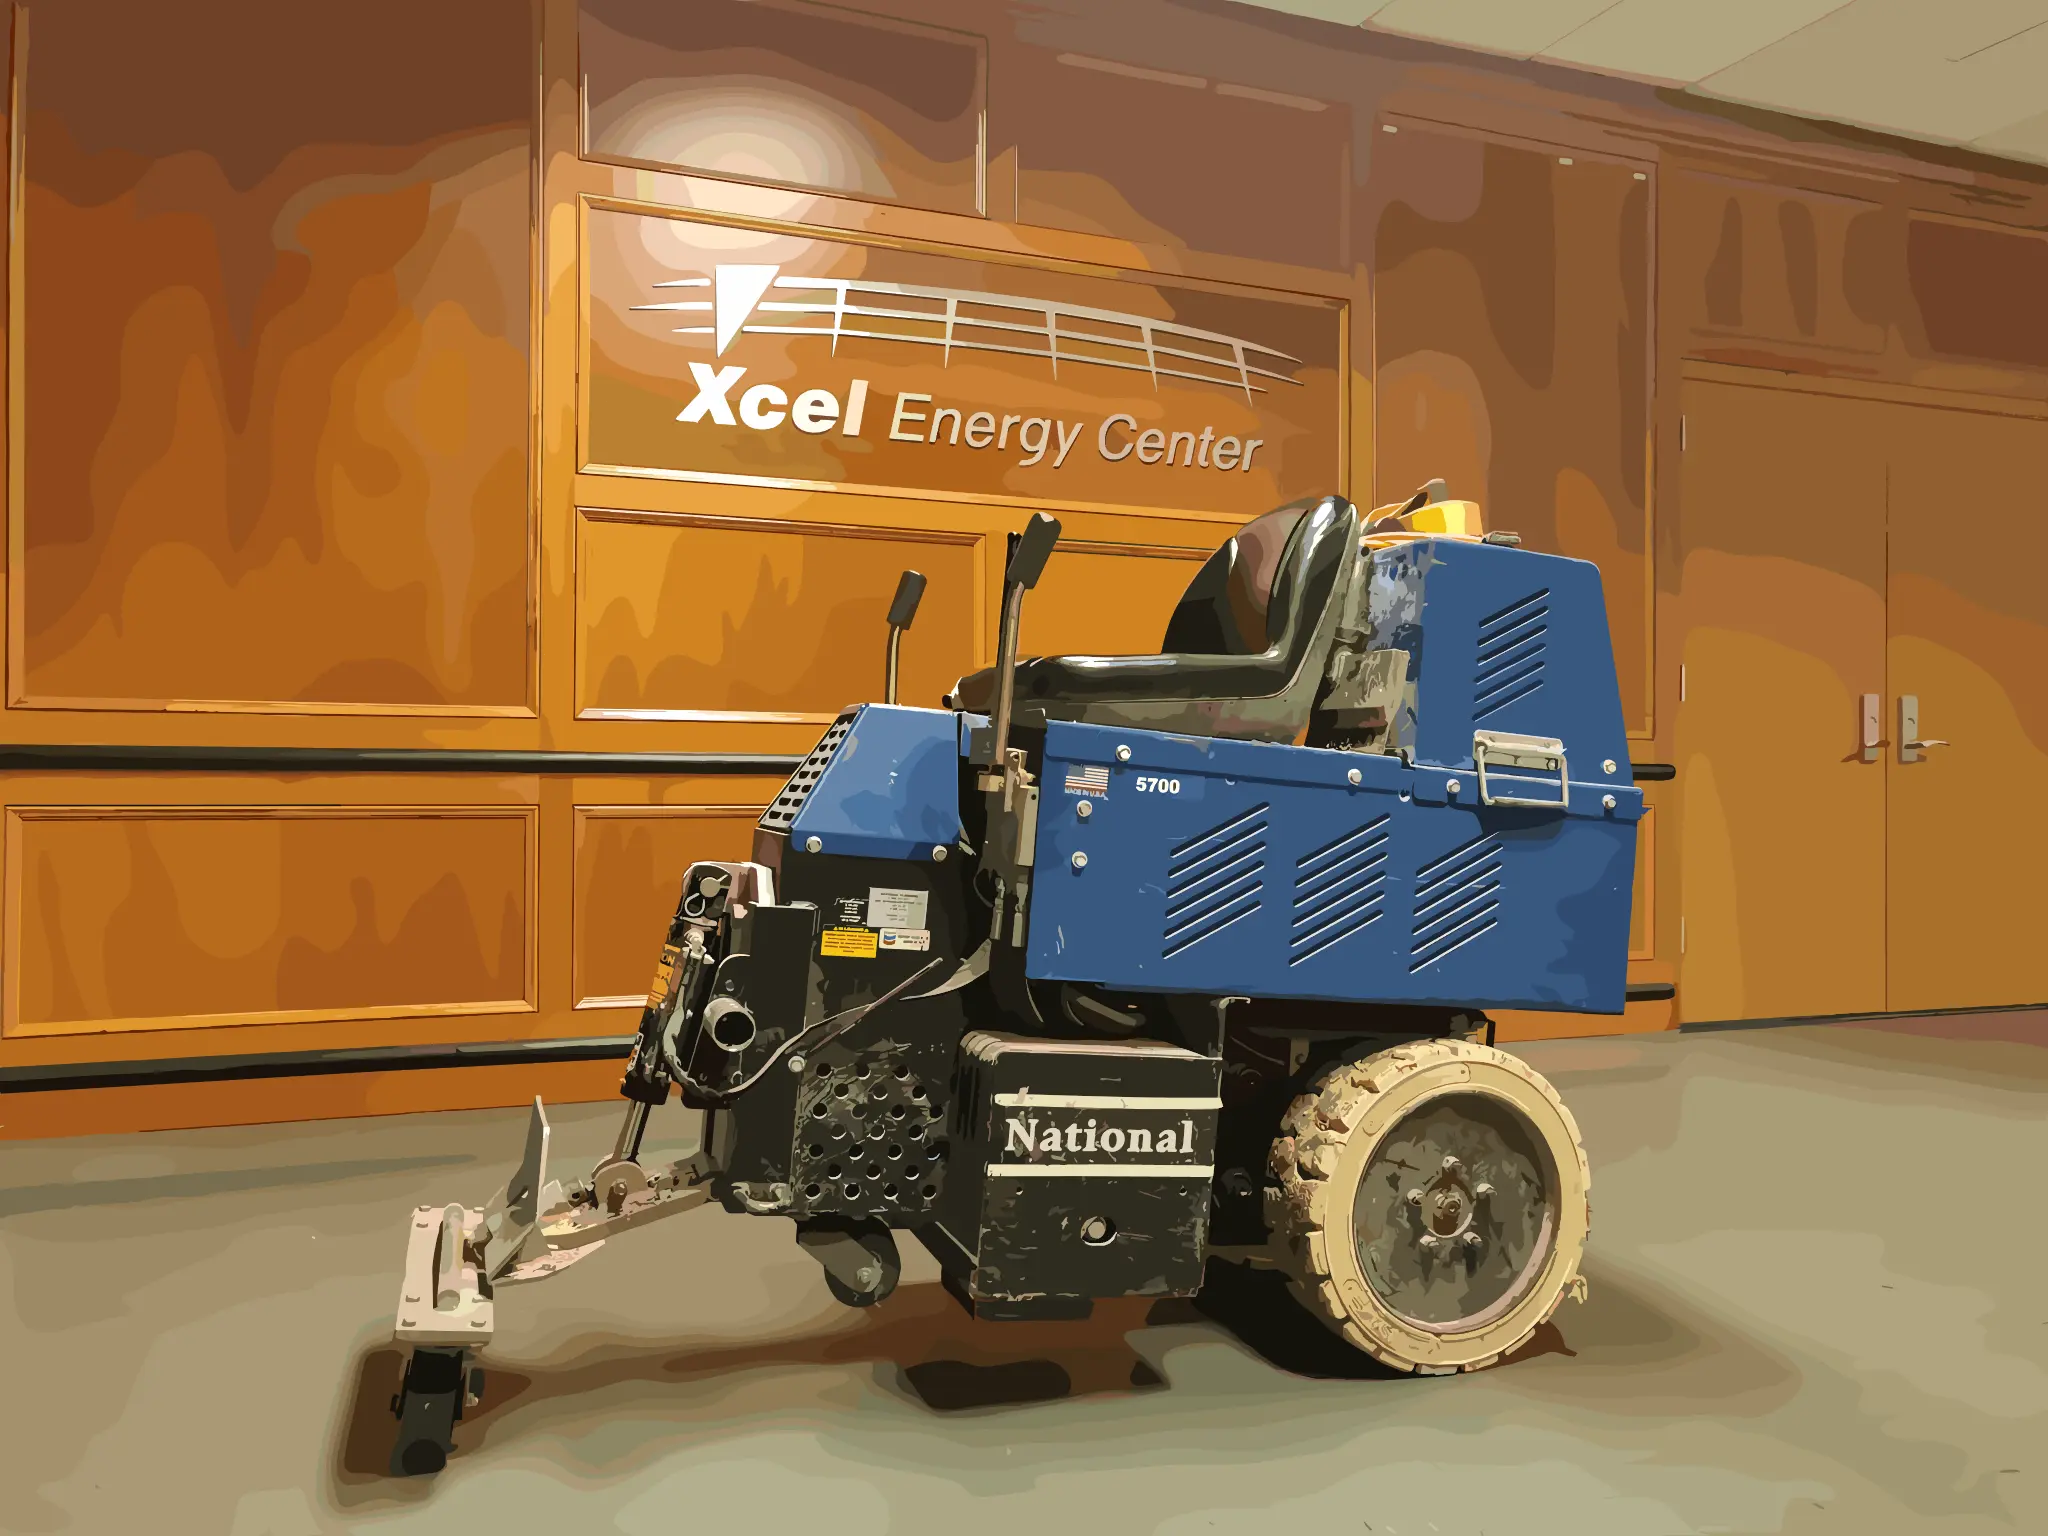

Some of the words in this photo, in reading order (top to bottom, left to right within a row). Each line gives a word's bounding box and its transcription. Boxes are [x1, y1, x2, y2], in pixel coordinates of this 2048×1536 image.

[675, 361, 869, 437] Xcel
[889, 391, 1084, 469] Energy
[1098, 413, 1264, 473] Center
[1135, 776, 1180, 795] 5700
[1004, 1117, 1195, 1154] National
